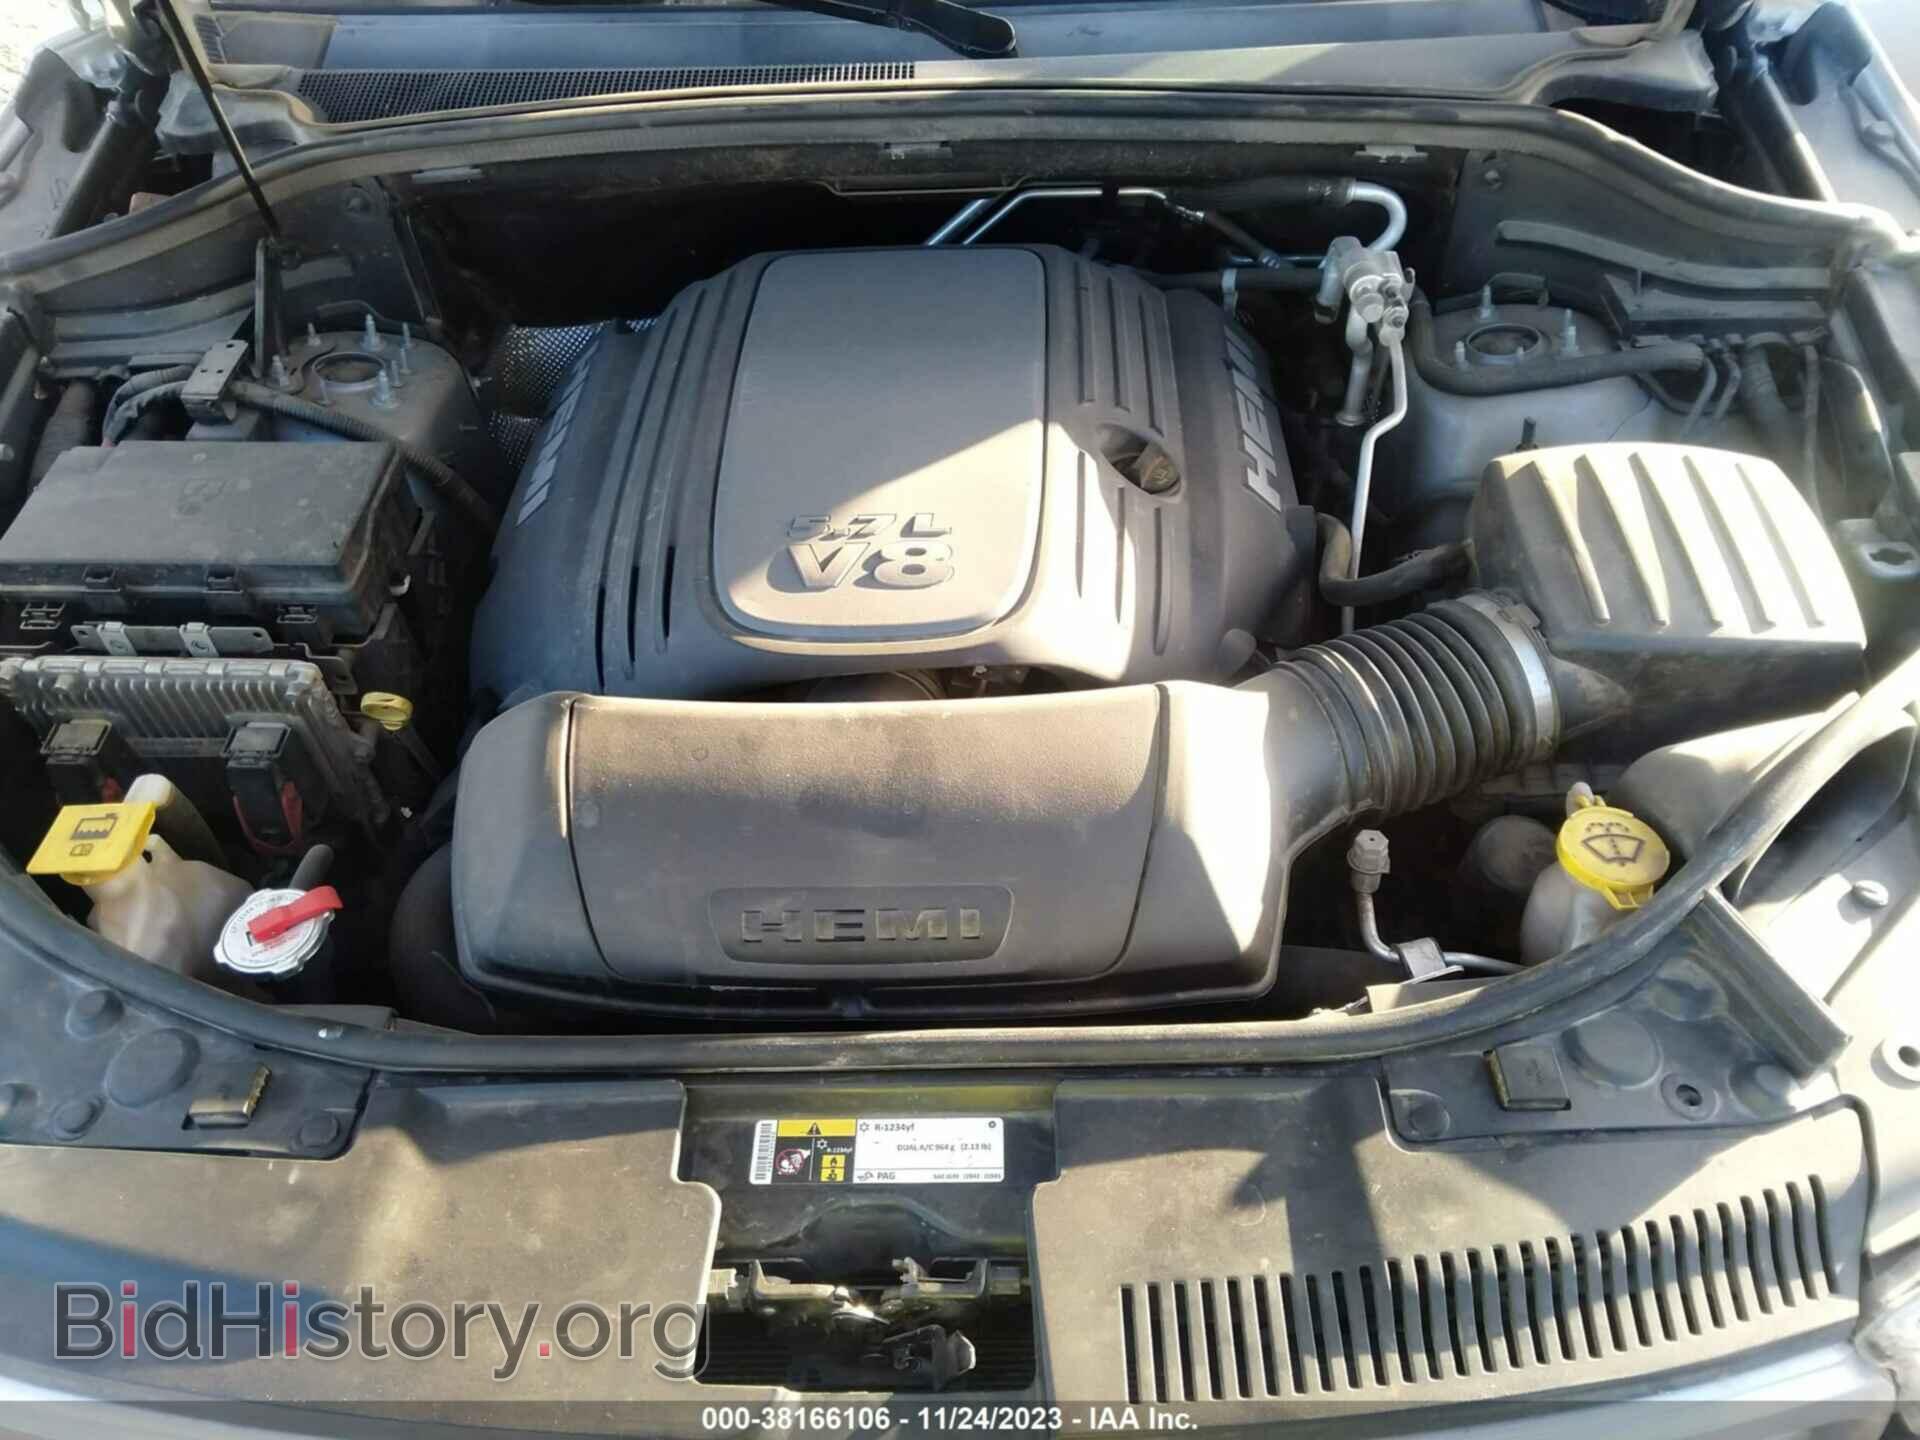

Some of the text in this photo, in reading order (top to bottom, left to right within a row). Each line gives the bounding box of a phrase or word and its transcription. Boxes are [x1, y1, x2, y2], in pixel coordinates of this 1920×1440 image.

[779, 541, 955, 590] V8
[741, 907, 981, 943] HEMI
[874, 1122, 915, 1133] R-1234yf
[876, 1171, 896, 1181] PAG
